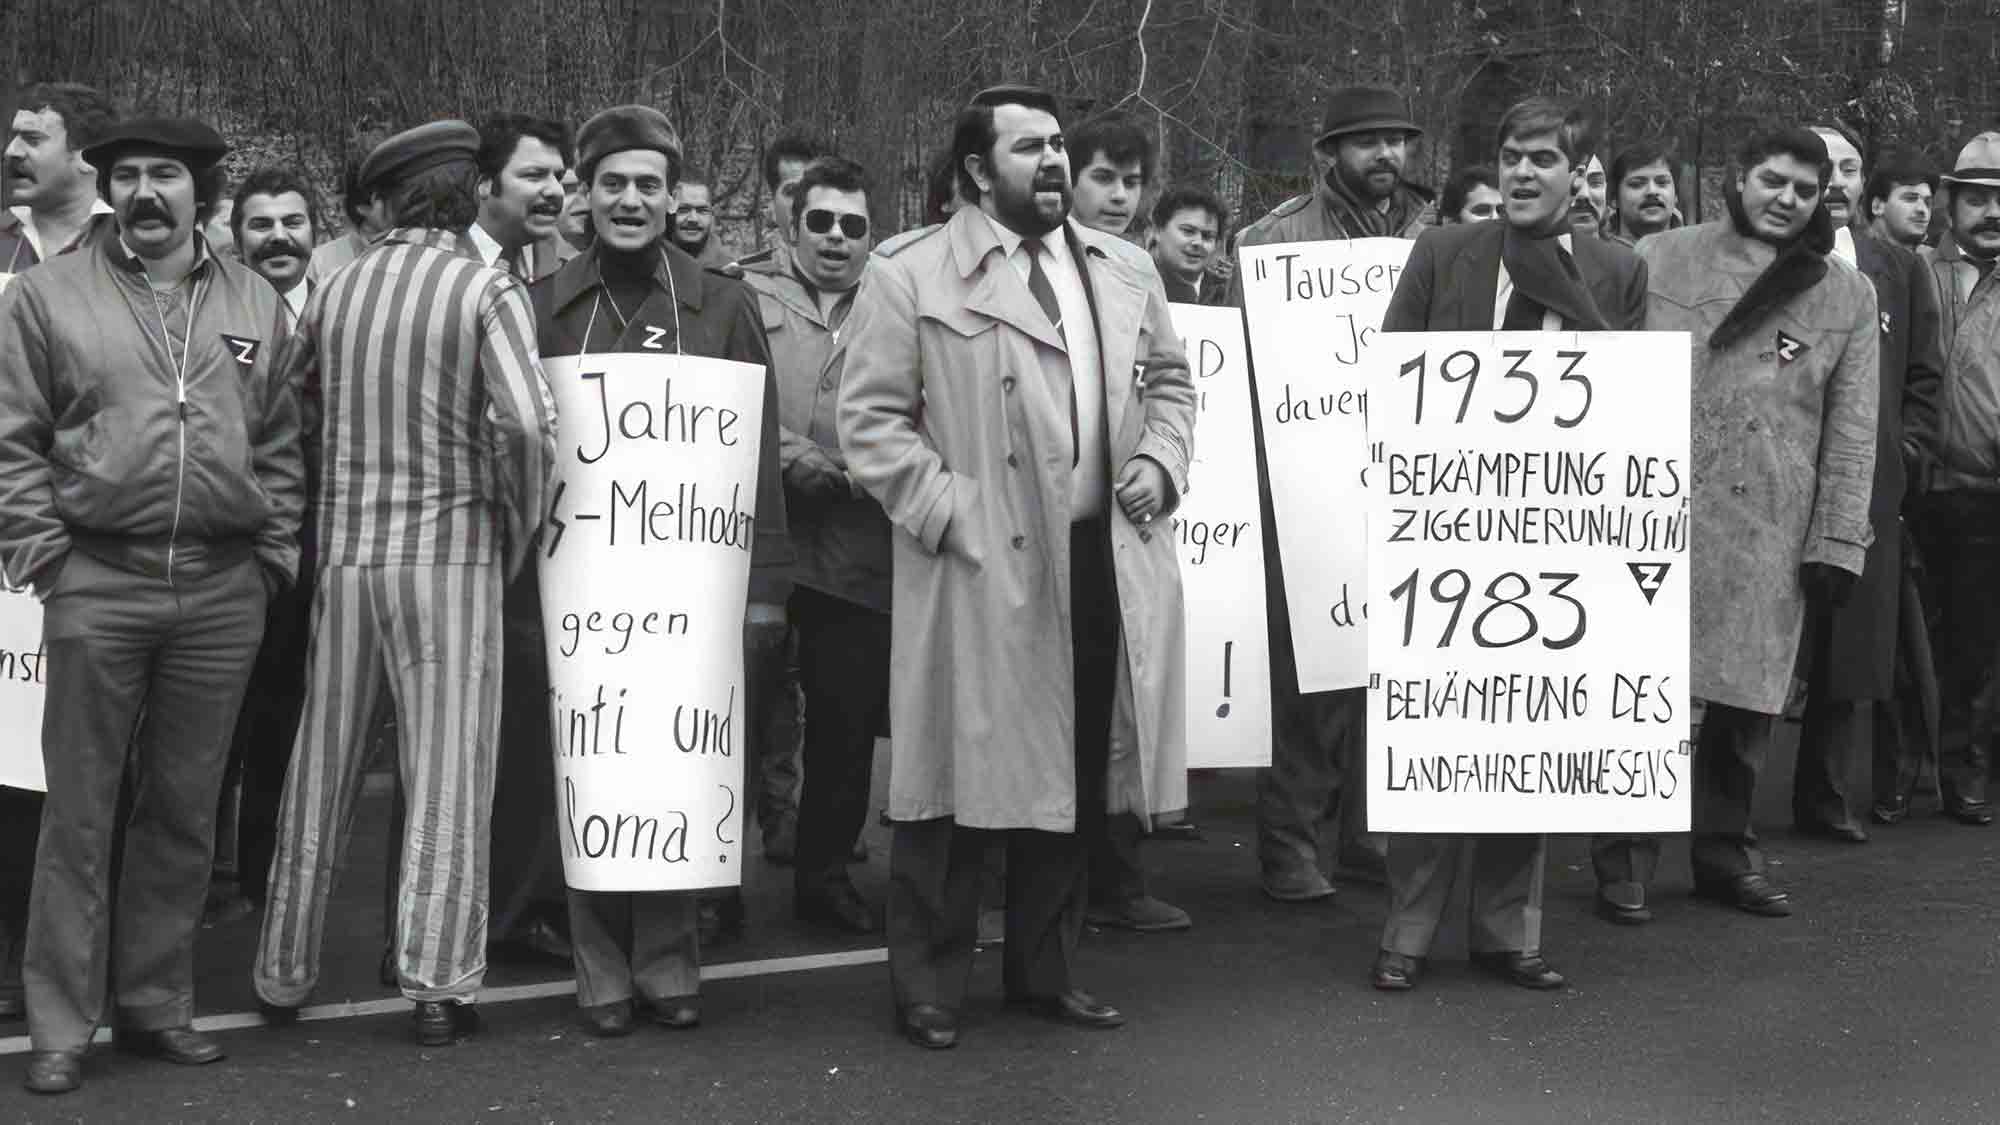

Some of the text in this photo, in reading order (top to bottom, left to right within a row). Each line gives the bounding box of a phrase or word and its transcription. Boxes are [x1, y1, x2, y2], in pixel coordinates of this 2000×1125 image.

[231, 339, 254, 364] Z
[642, 325, 667, 349] Z
[1779, 336, 1800, 362] Z
[1400, 349, 1593, 429] 1933
[577, 372, 738, 465] Jahre
[1372, 441, 1607, 498] "BEKÄMPFUNG
[1626, 455, 1680, 498] DES
[559, 611, 688, 657] gegen
[1389, 567, 1587, 650] 1983
[553, 684, 736, 758] inti und
[1612, 672, 1673, 723] DES
